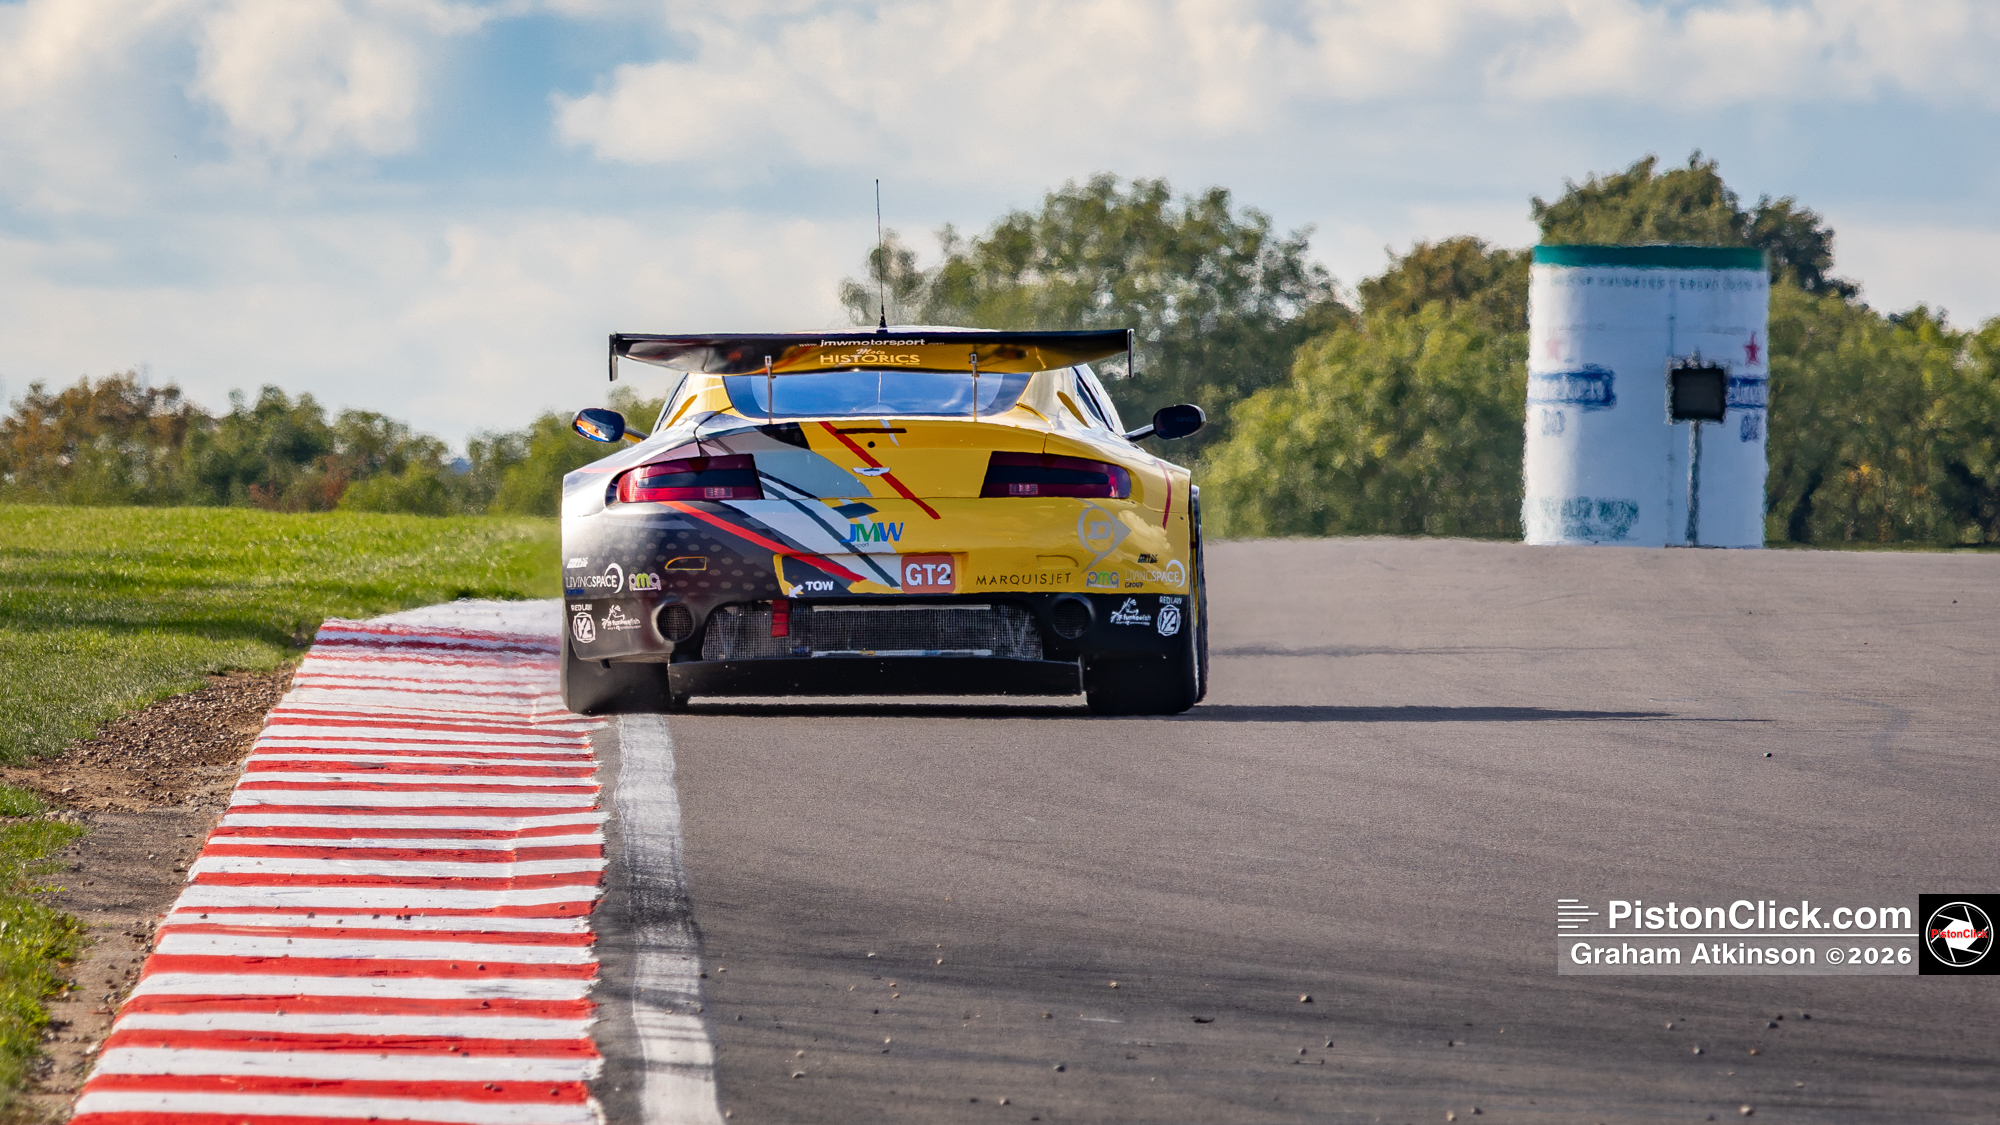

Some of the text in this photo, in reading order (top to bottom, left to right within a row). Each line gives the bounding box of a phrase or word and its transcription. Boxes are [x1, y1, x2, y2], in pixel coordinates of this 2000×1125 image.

[820, 339, 925, 347] jmwmotorsport
[820, 354, 920, 363] HISTORICS
[840, 522, 904, 543] JMW
[905, 563, 951, 586] GT2
[805, 580, 834, 591] TOW
